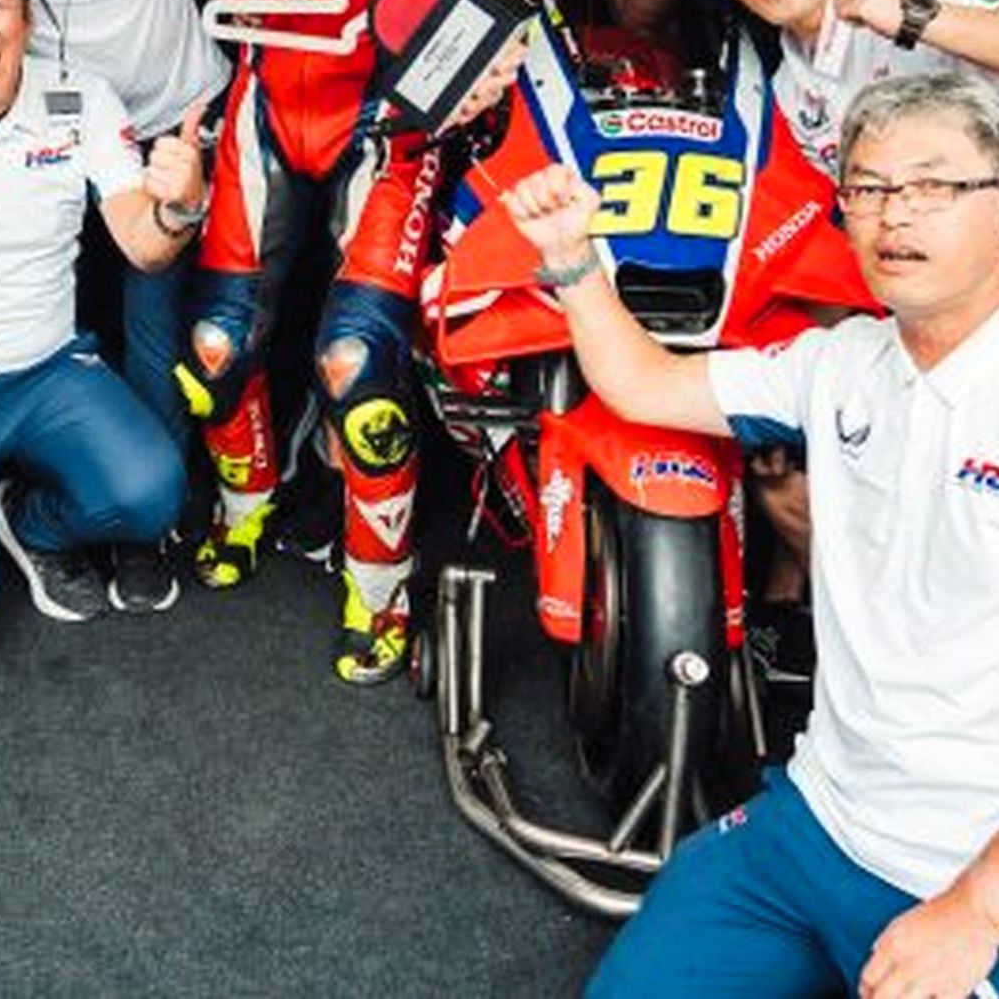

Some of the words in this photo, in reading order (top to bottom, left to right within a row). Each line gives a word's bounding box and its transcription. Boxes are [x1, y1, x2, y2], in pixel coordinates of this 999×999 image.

[626, 113, 718, 139] Castrol
[589, 150, 745, 240] 36
[753, 200, 823, 262] HONDA
